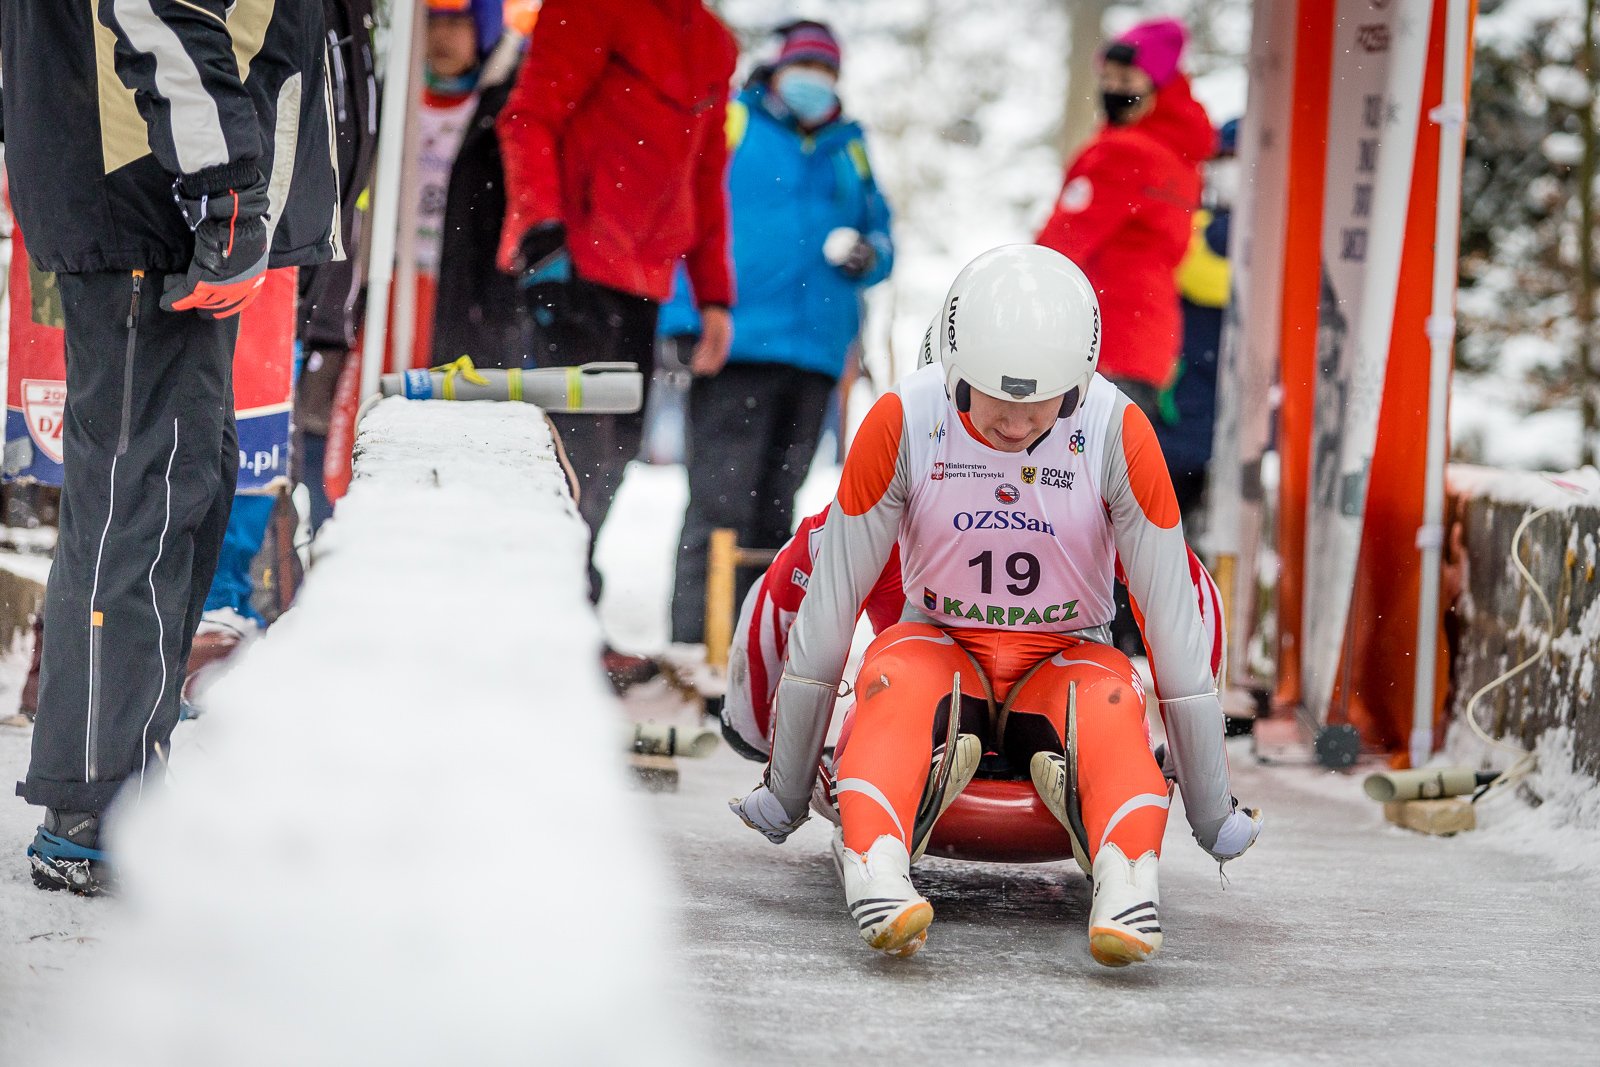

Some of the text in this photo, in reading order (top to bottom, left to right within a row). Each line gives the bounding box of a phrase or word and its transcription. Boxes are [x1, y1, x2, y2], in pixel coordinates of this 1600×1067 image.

[948, 296, 959, 354] uvex
[1087, 305, 1099, 362] uvex
[944, 462, 987, 470] Ministerstwo
[944, 471, 967, 479] Sportu
[972, 471, 1005, 480] Turystyki
[1042, 467, 1076, 481] DOLNY
[953, 511, 1055, 536] OZSSan
[968, 550, 1041, 596] 19
[943, 596, 1080, 626] KARPACZ
